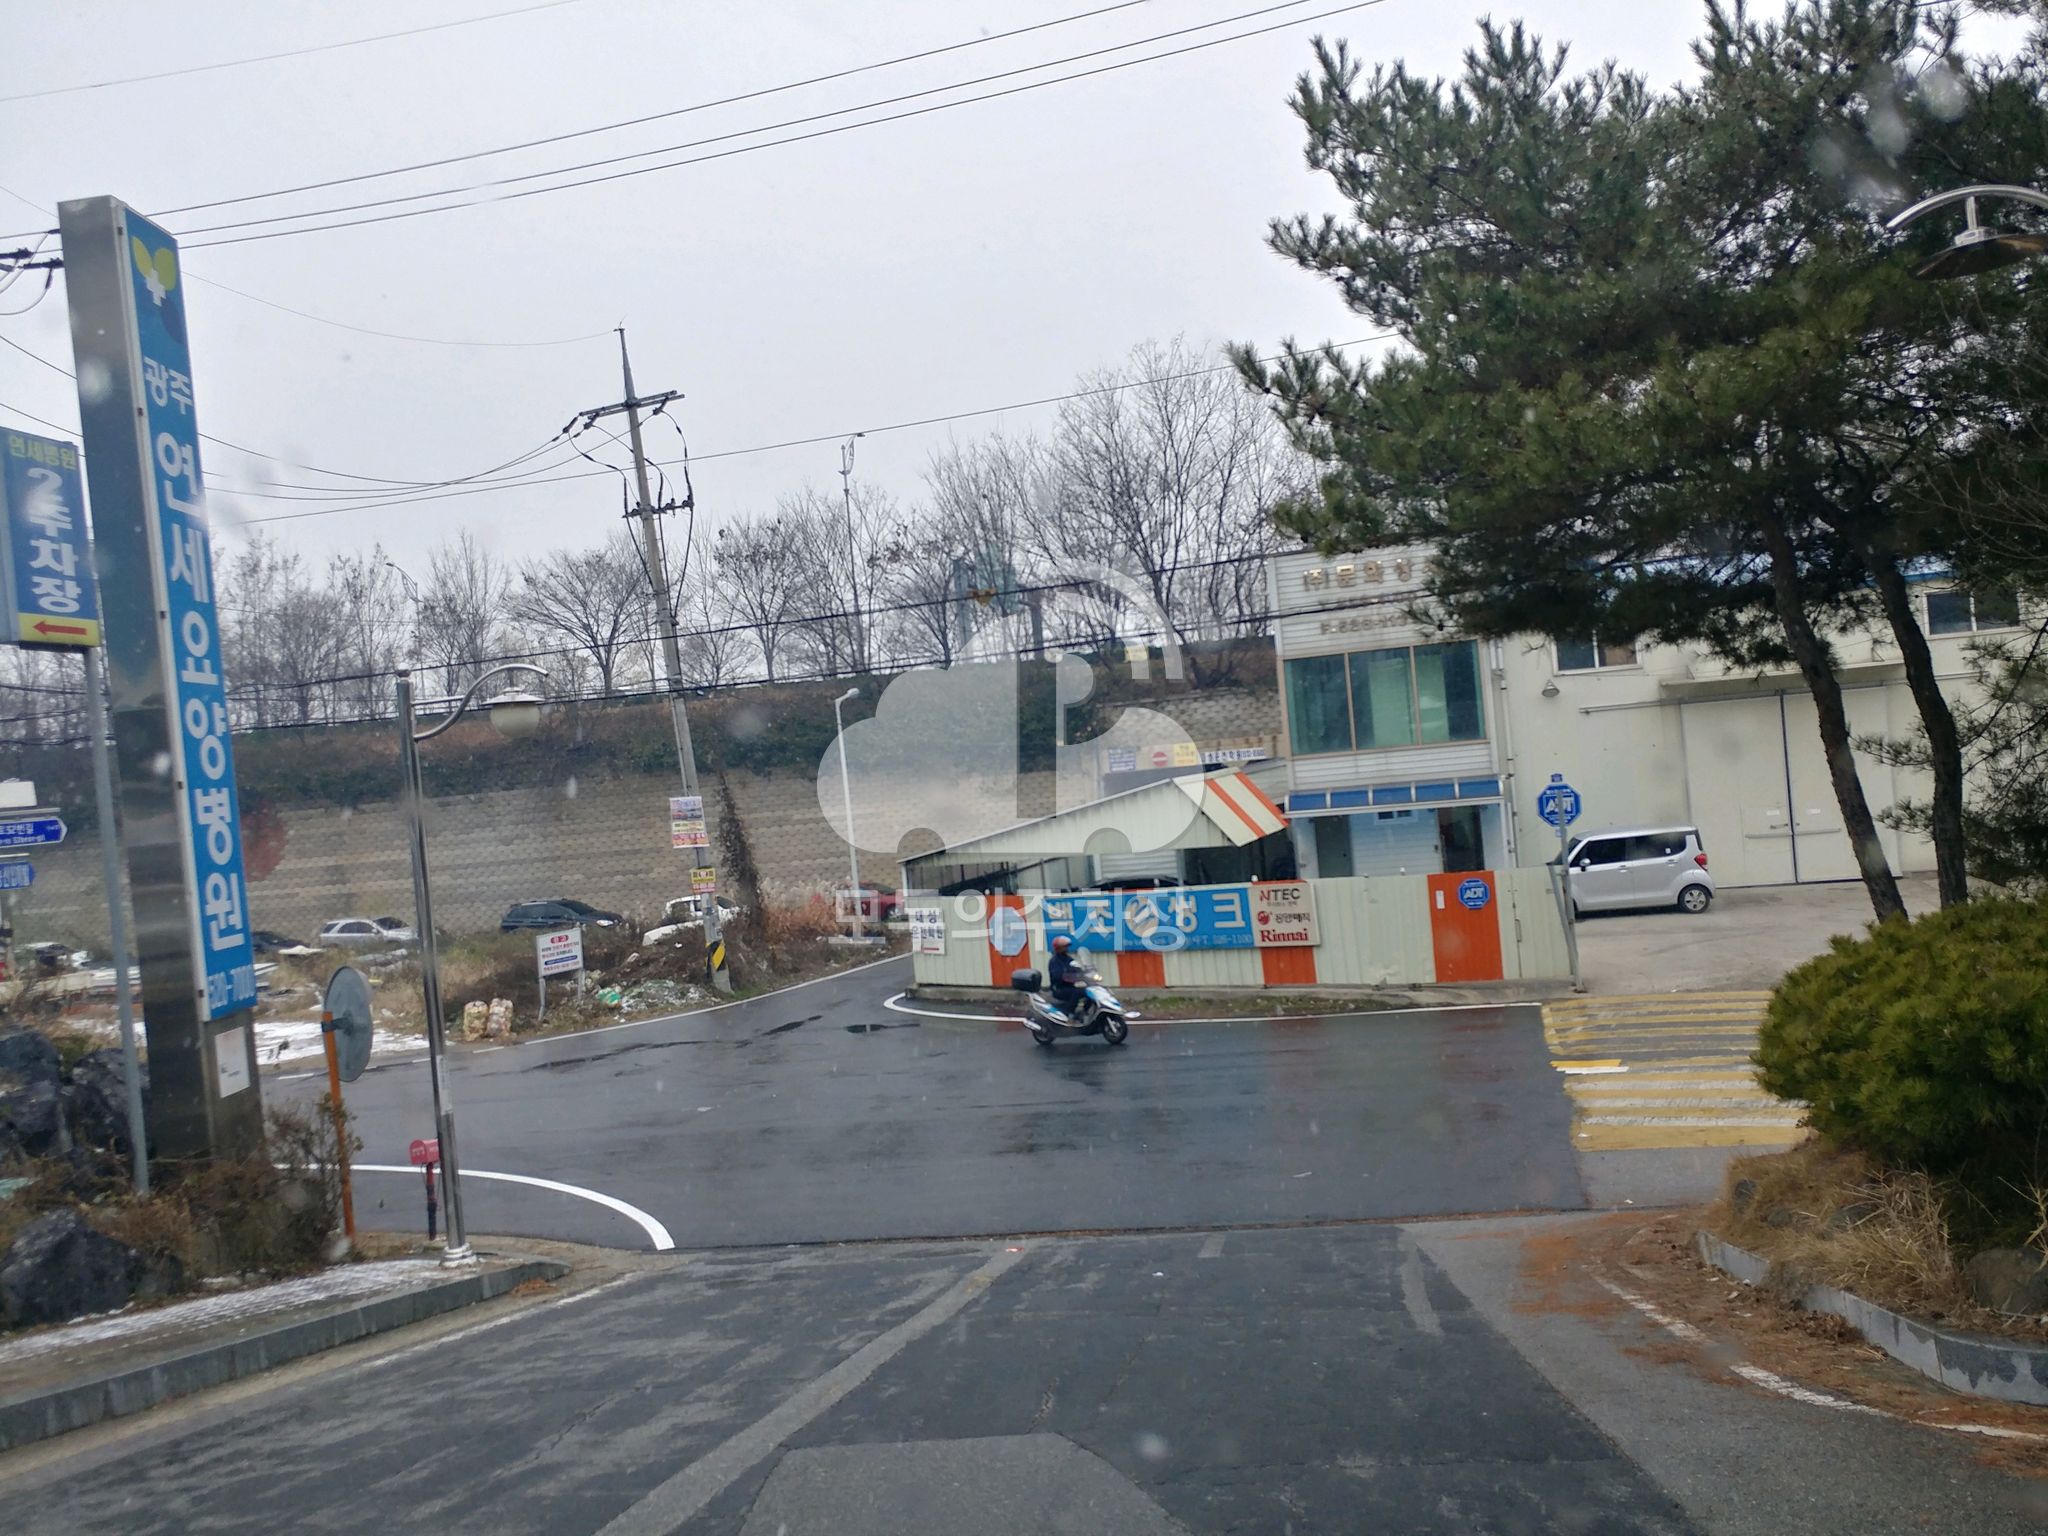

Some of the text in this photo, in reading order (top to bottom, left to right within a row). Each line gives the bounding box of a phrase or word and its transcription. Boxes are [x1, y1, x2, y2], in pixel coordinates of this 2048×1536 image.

[144, 355, 192, 415] 광주
[8, 434, 77, 470] 연세병원
[155, 431, 246, 952] 연세요양병원
[1259, 888, 1301, 903] NTEC
[1463, 887, 1485, 899] ADT
[1259, 928, 1310, 943] Rinnai
